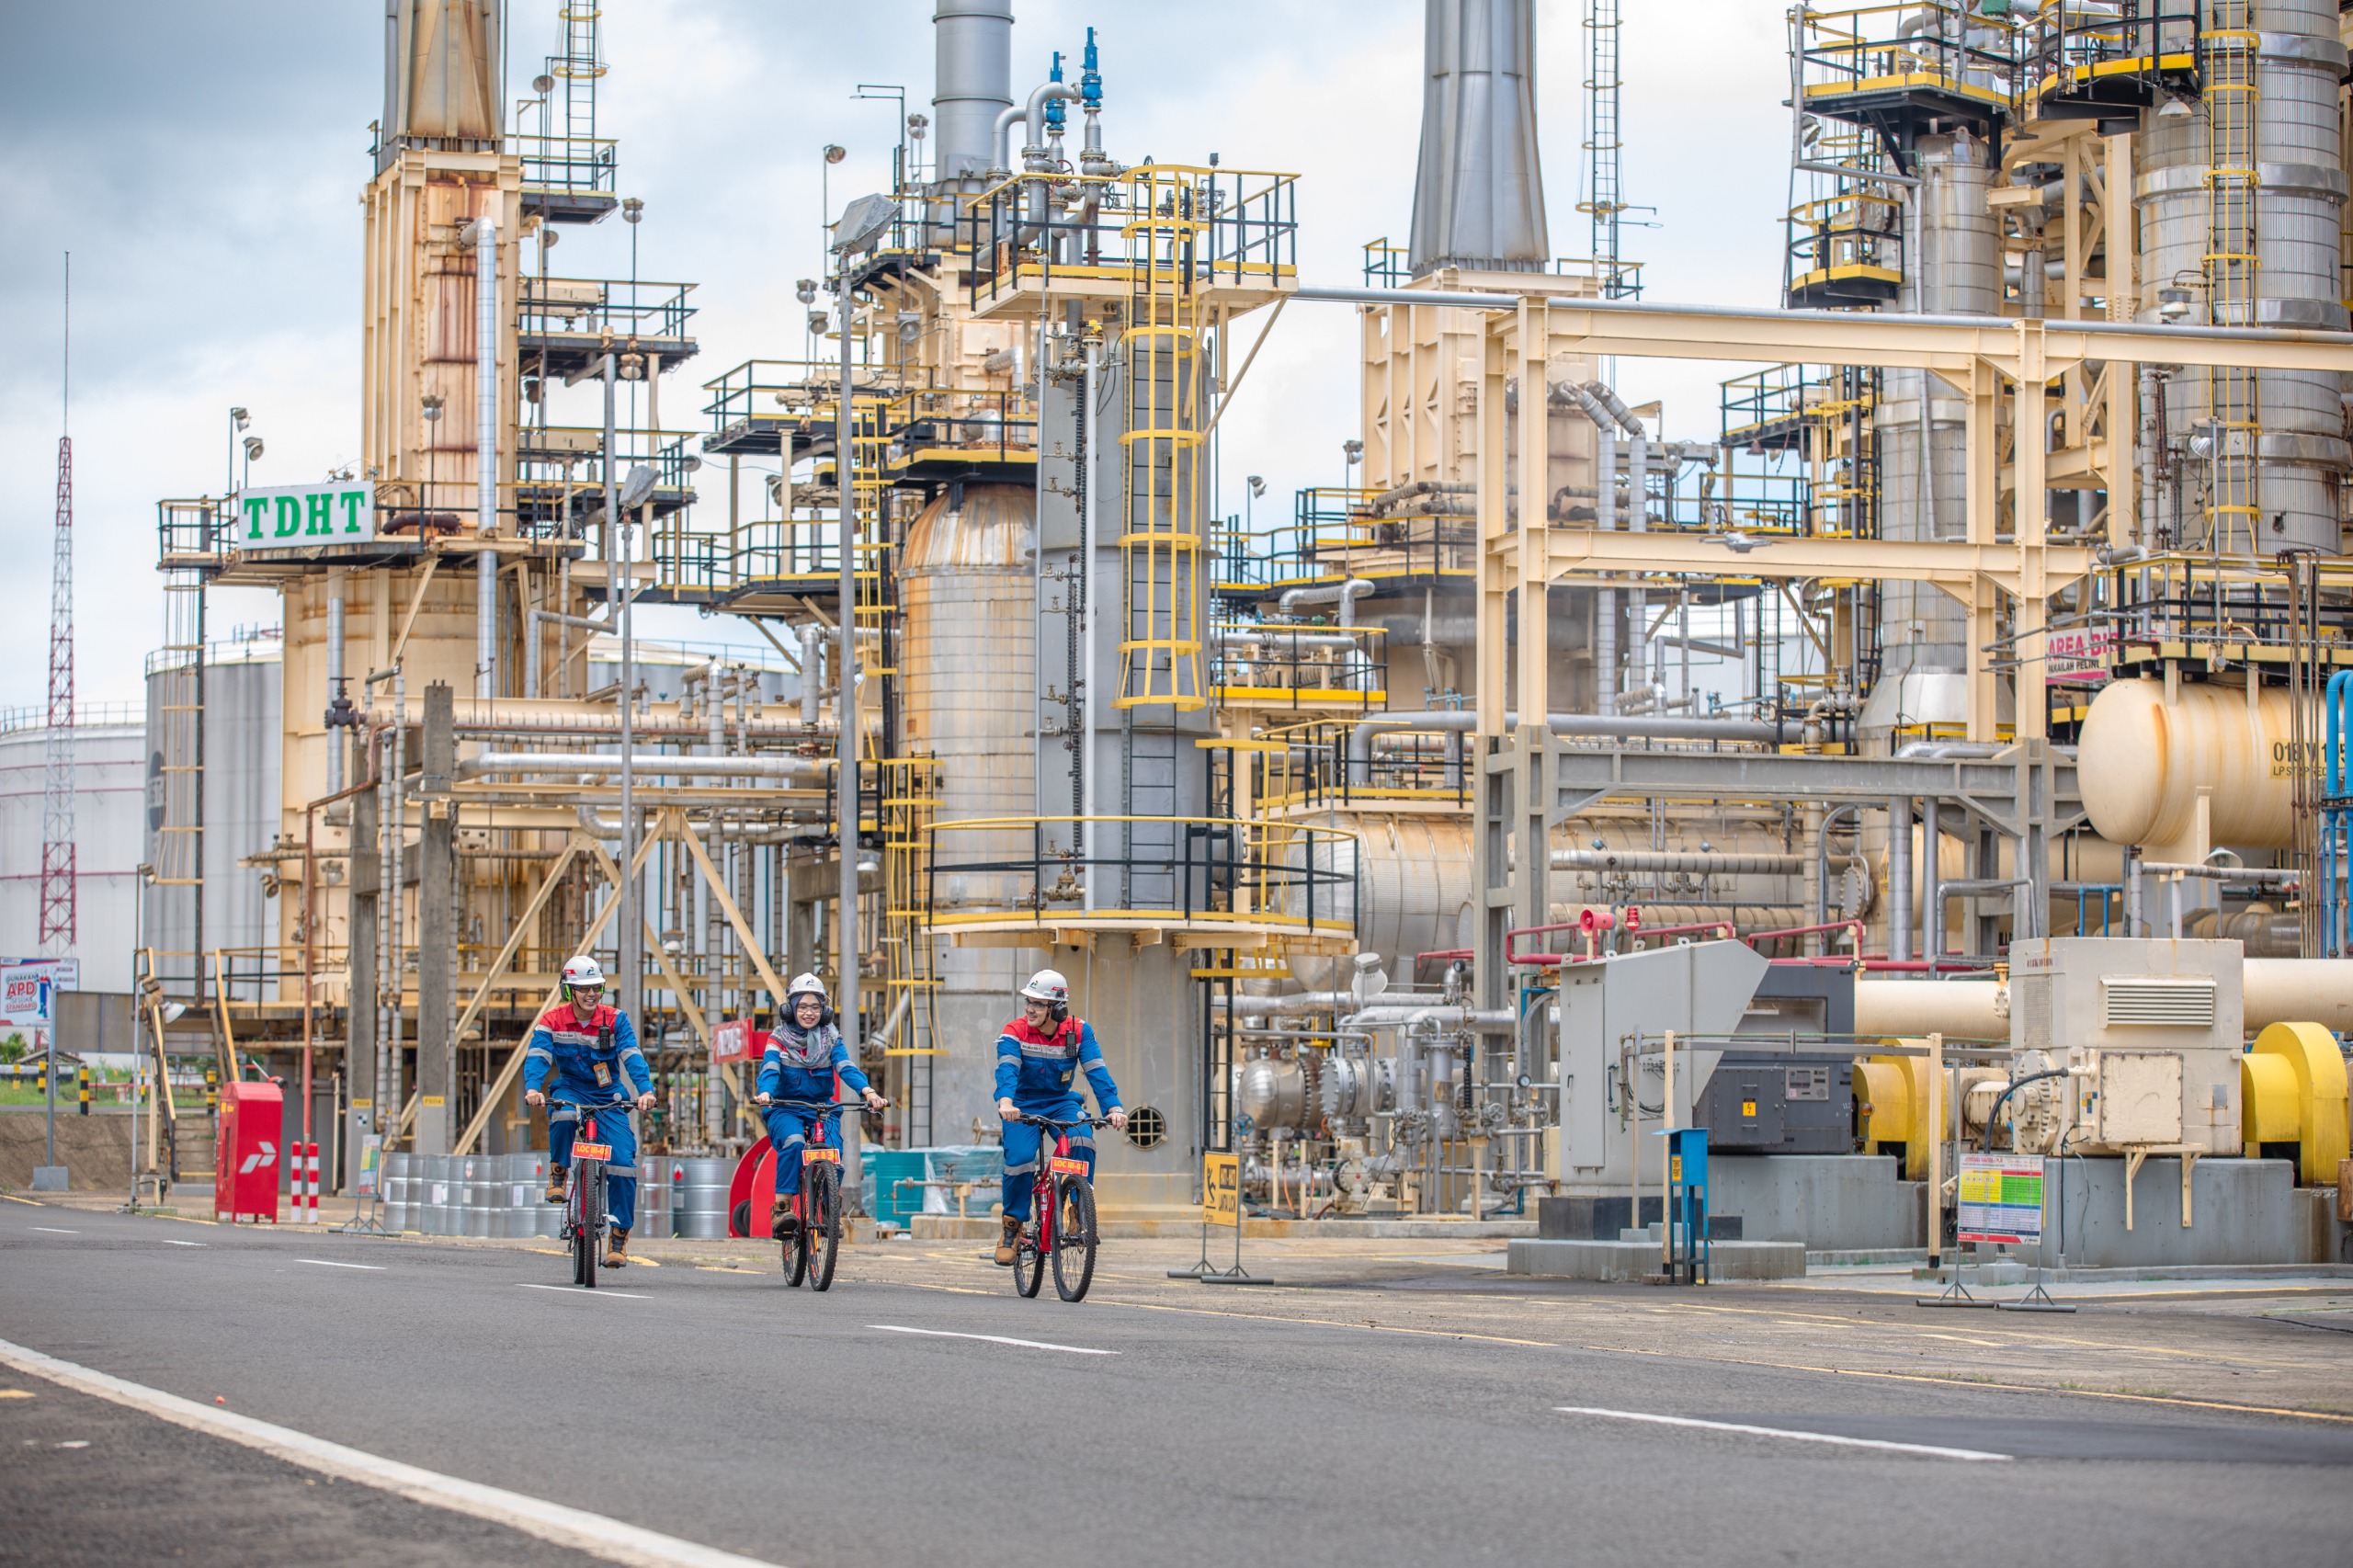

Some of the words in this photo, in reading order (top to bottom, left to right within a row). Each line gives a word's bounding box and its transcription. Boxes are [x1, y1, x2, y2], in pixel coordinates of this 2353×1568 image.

[244, 491, 366, 540] TDHT
[2048, 634, 2086, 661] AREA
[6, 973, 37, 983] GUNAKAN
[6, 981, 36, 997] APD
[576, 1144, 590, 1153] LOC
[1053, 1159, 1066, 1168] LOC
